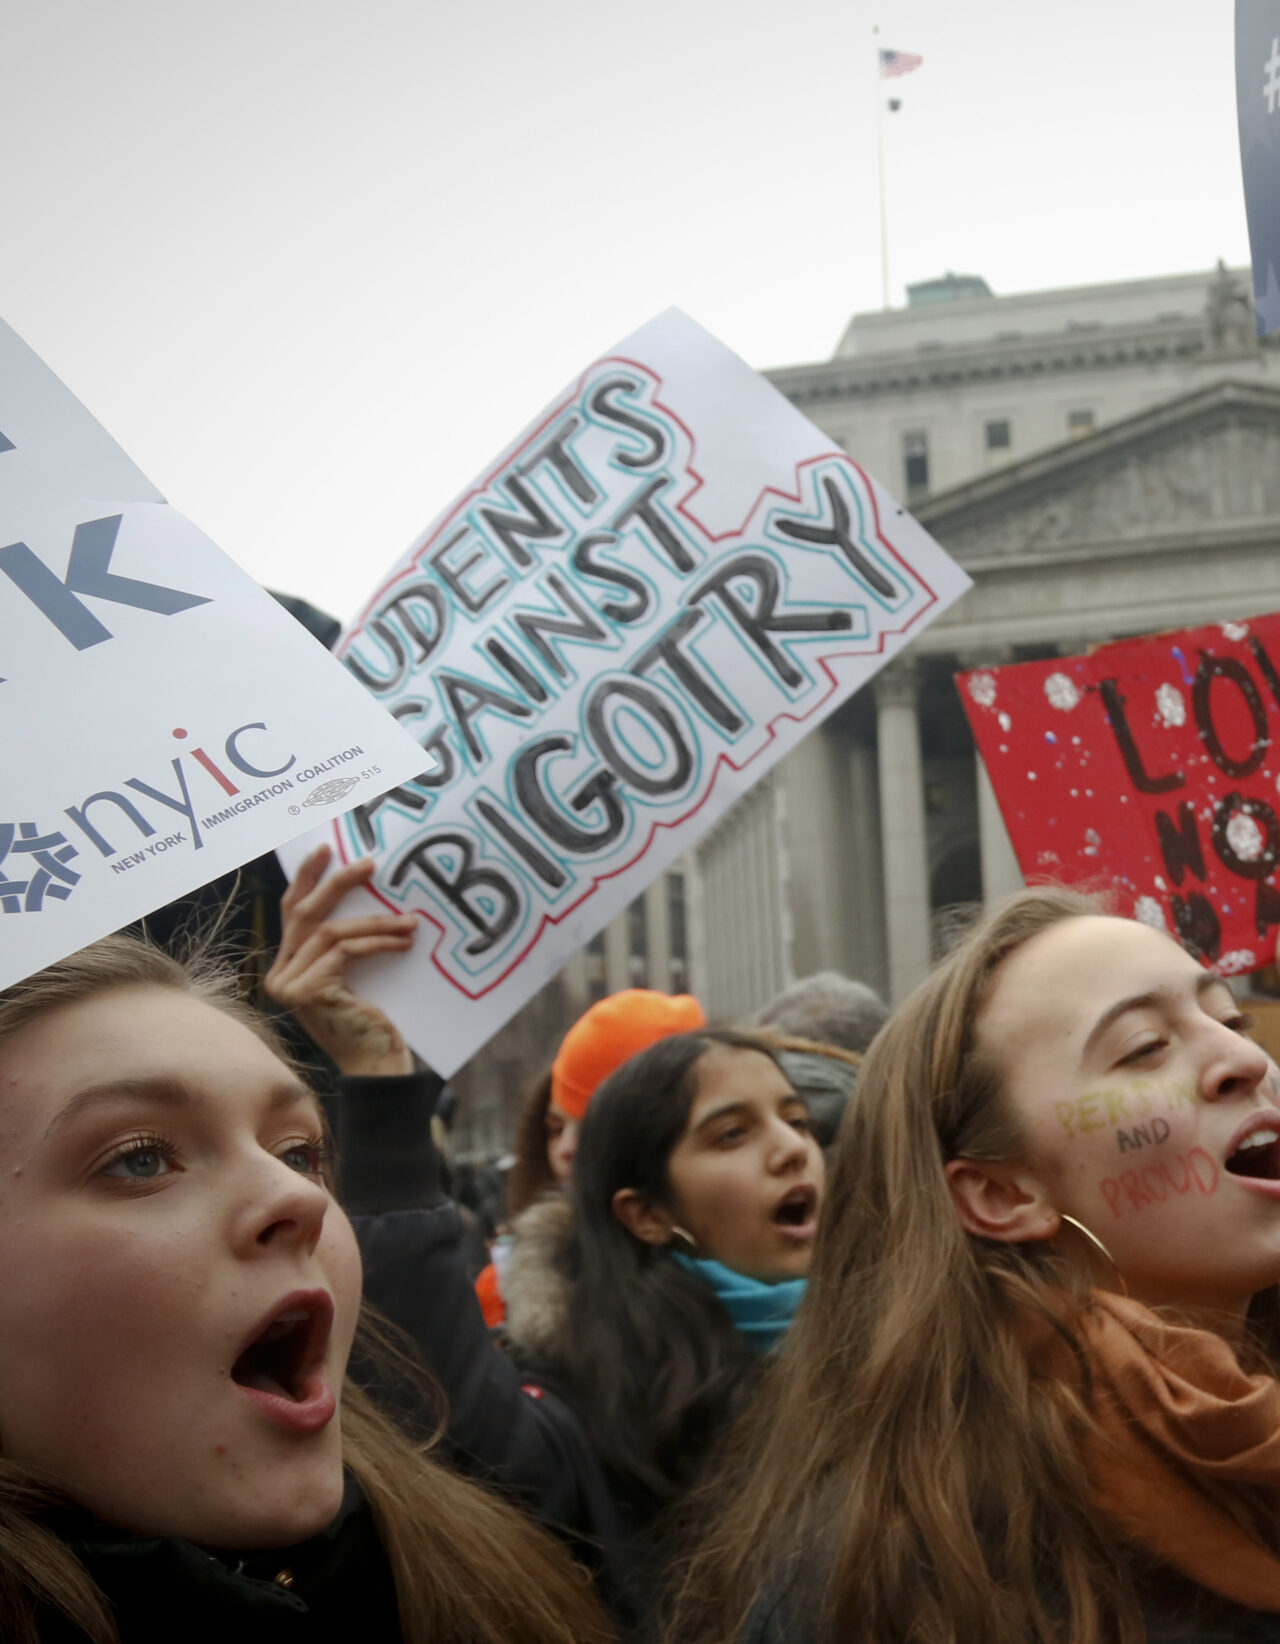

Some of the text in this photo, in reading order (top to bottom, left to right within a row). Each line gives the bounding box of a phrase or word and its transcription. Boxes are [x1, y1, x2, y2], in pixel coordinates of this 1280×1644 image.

[346, 379, 664, 692] UDENTS
[360, 765, 382, 781] 515
[391, 476, 896, 956] BIGOTRY
[64, 722, 296, 857] nyic
[111, 851, 147, 875] NEW
[145, 831, 187, 858] YORK
[201, 780, 294, 829] IMMIGRATION
[296, 745, 364, 783] COALITION
[1100, 1147, 1219, 1219] PROUD
[1116, 1118, 1170, 1153] AND
